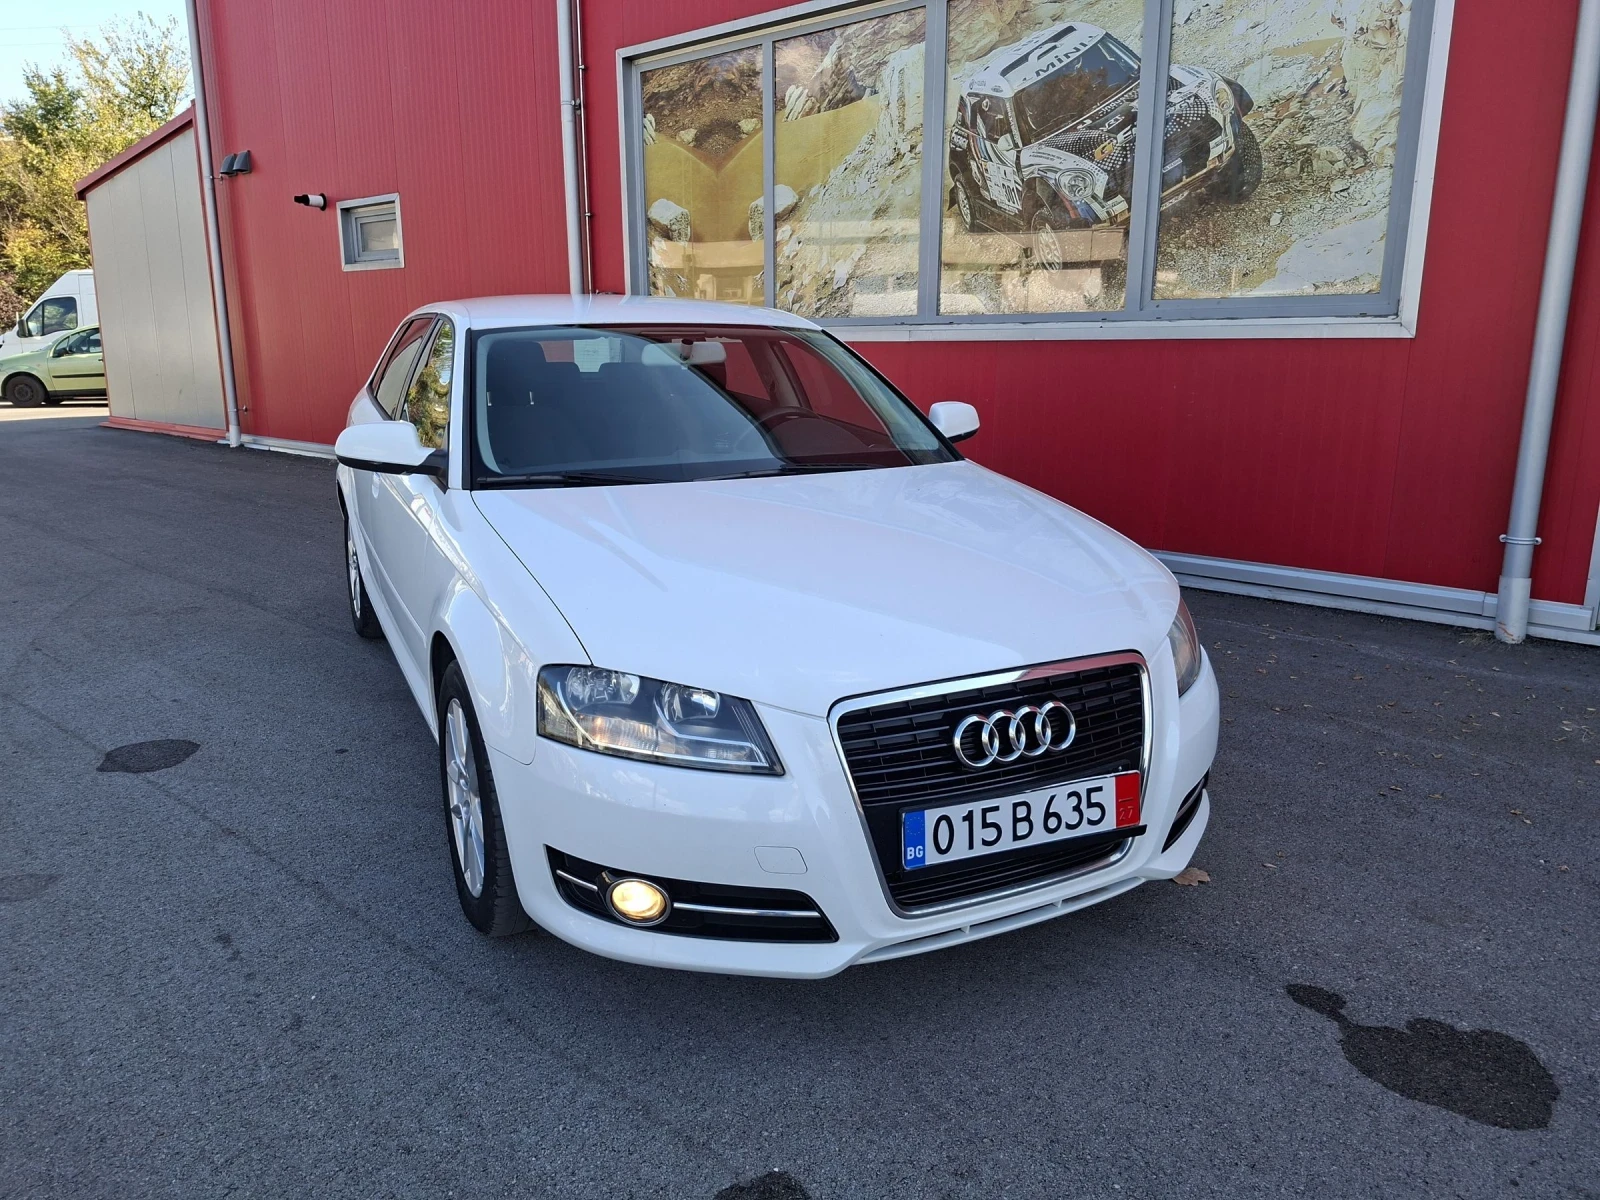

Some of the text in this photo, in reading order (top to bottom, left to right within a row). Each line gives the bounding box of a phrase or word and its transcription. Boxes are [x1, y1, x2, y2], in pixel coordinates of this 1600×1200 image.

[932, 785, 1106, 855] 015 B 635
[907, 845, 924, 860] BG
